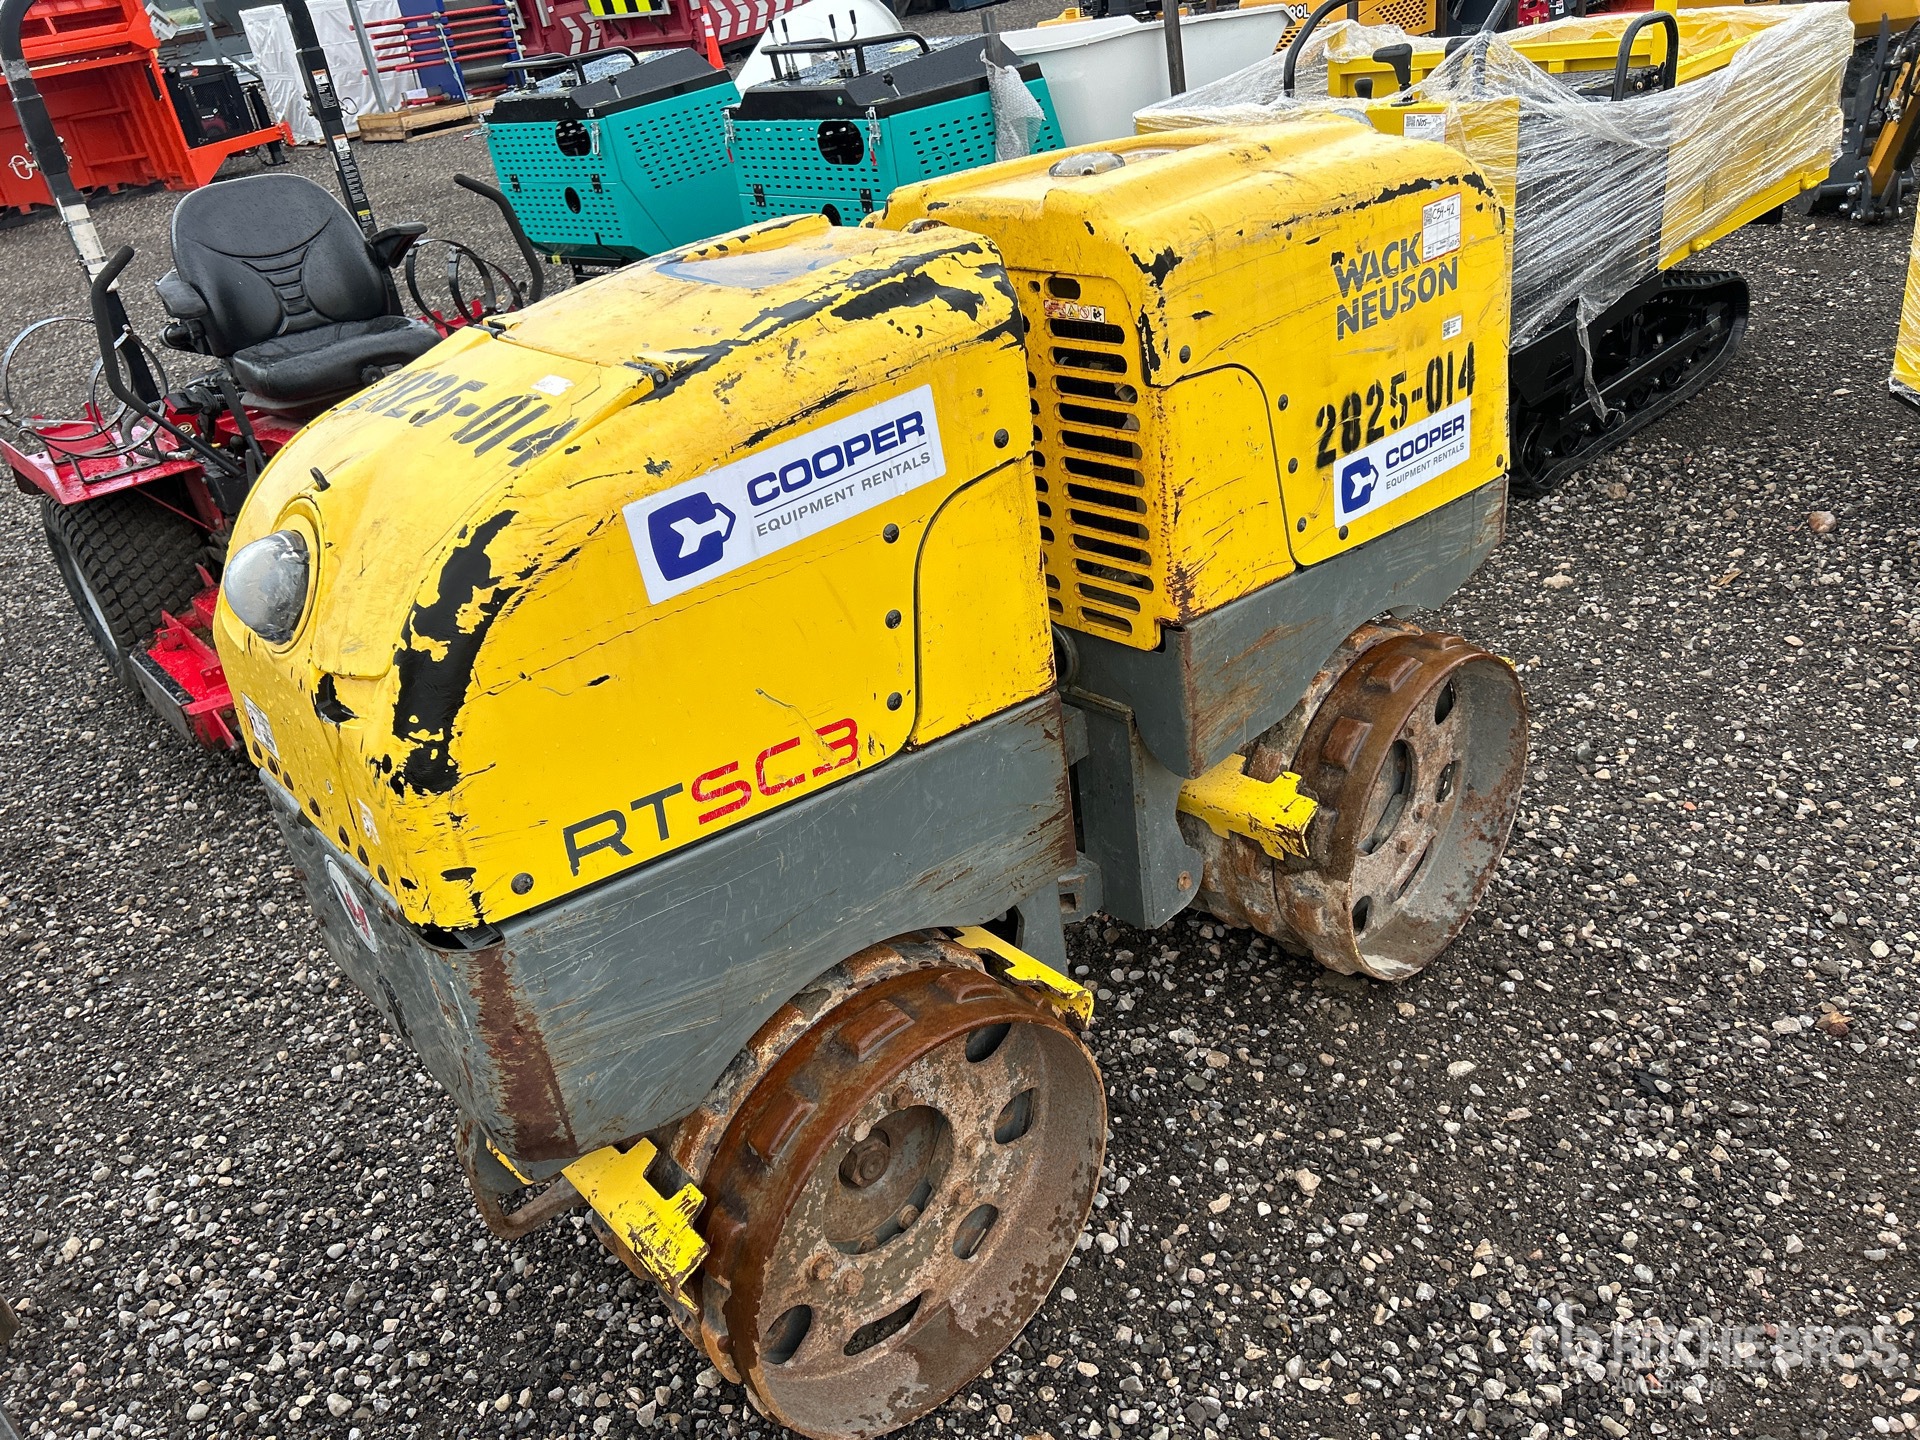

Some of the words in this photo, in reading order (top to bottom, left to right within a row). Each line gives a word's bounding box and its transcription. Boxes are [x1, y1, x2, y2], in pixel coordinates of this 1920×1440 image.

[1334, 232, 1422, 298] WACK
[1337, 256, 1458, 341] NEUSON
[1316, 341, 1476, 468] 2825-014
[1386, 414, 1465, 469] COOPER
[747, 410, 927, 507] COOPER
[756, 484, 856, 538] EQUIPMENT
[861, 452, 931, 496] RENTALS
[1386, 459, 1431, 490] EQUIPMENT
[1433, 442, 1465, 467] RENTALS
